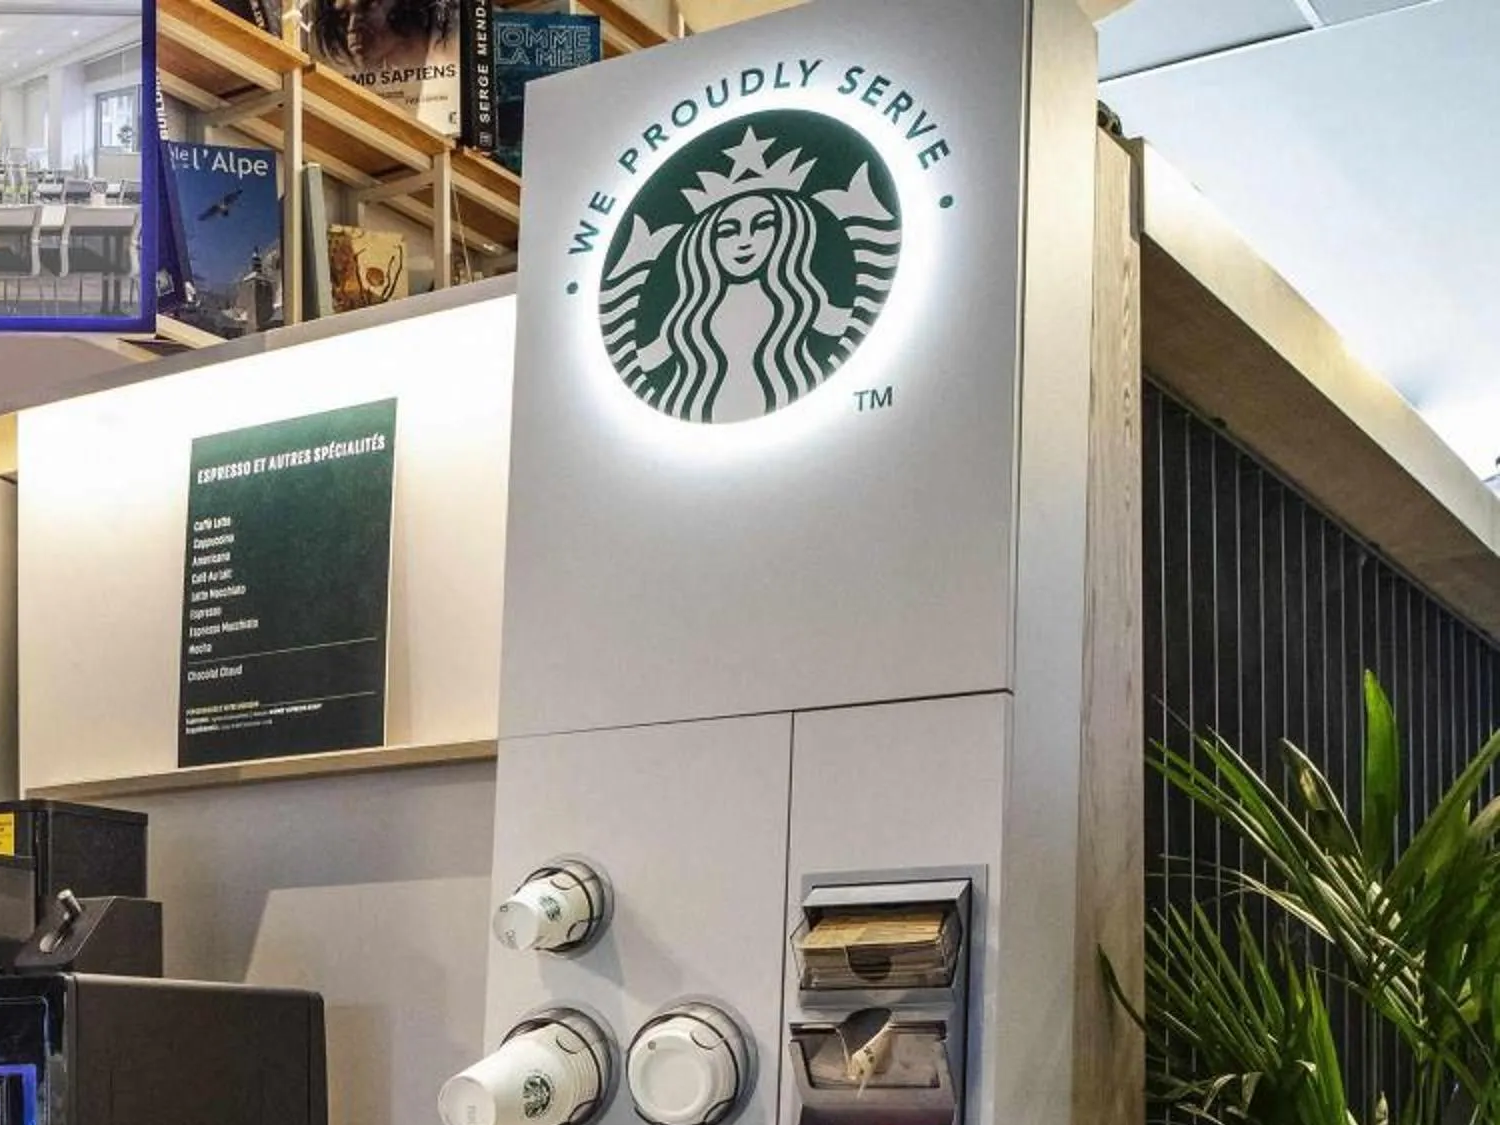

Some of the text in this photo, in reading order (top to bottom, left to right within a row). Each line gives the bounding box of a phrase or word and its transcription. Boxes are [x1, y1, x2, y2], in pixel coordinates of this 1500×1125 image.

[381, 63, 456, 85] SAPIENS
[476, 0, 490, 123] SERGE MEND
[193, 147, 269, 180] l'Alpe
[568, 58, 951, 255] WE PROUDLY SERVE
[853, 386, 894, 412] TM
[197, 432, 386, 485] ESPRESSO ET AUTRES SPÉCIALITÉS
